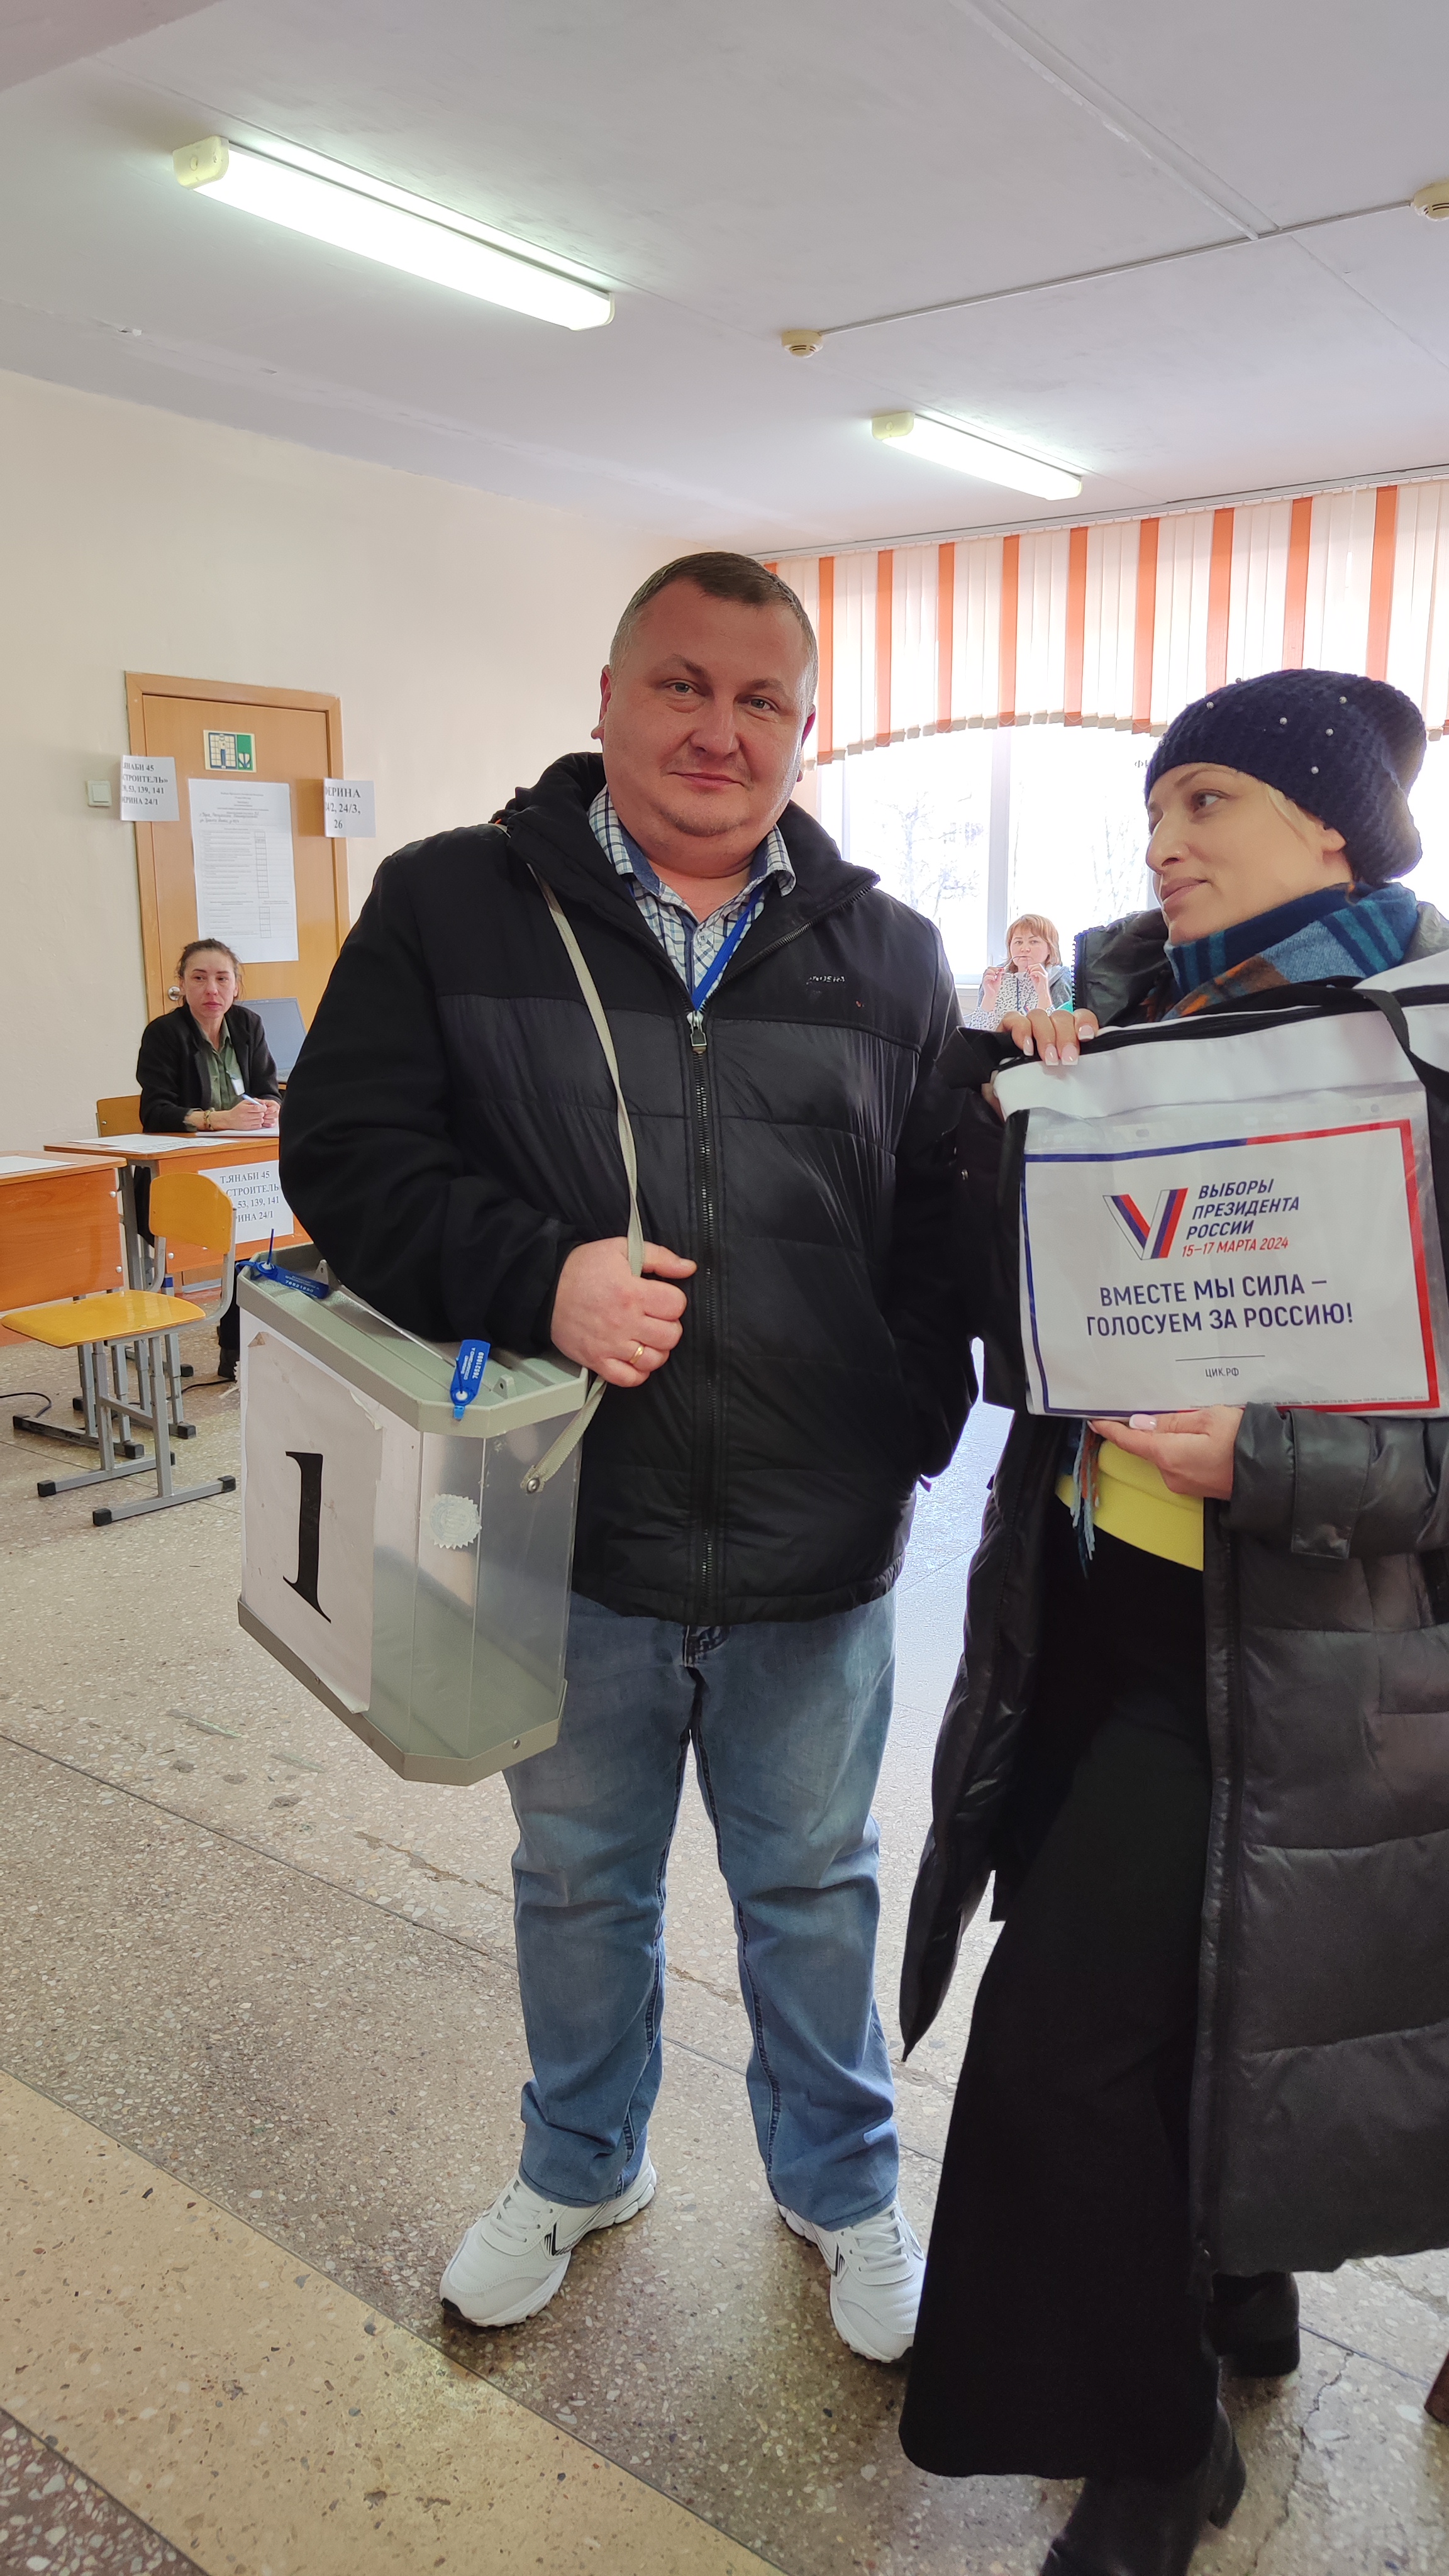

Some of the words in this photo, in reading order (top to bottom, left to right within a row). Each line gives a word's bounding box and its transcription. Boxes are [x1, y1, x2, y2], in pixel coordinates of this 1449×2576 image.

[138, 786, 151, 794] 139,
[339, 804, 361, 816] 24/3,
[334, 819, 343, 829] 26
[220, 1172, 259, 1184] Т.ЯНАБИ
[261, 1170, 270, 1179] 45
[1197, 1178, 1275, 1200] ВЫБОРЫ
[238, 1200, 249, 1209] 53,
[251, 1197, 265, 1207] 139,
[268, 1196, 280, 1204] 141
[1192, 1196, 1300, 1220] ПРЕЗИДЕНТА
[259, 1210, 273, 1219] 24/1
[1186, 1219, 1255, 1241] РОССИИ
[1216, 1238, 1257, 1254] МАРТА
[1259, 1236, 1289, 1251] 2024
[1099, 1282, 1187, 1307] ВМЕСТЕ
[1193, 1277, 1235, 1301] МЫ
[1242, 1274, 1306, 1297] СИЛА
[1086, 1311, 1202, 1336] ГОЛОСУЕМ
[1209, 1308, 1238, 1330] ЗА
[1243, 1302, 1353, 1328] РОССИЮ!
[1204, 1367, 1240, 1379] ЦИК.РФ
[282, 1450, 332, 1624] 1
